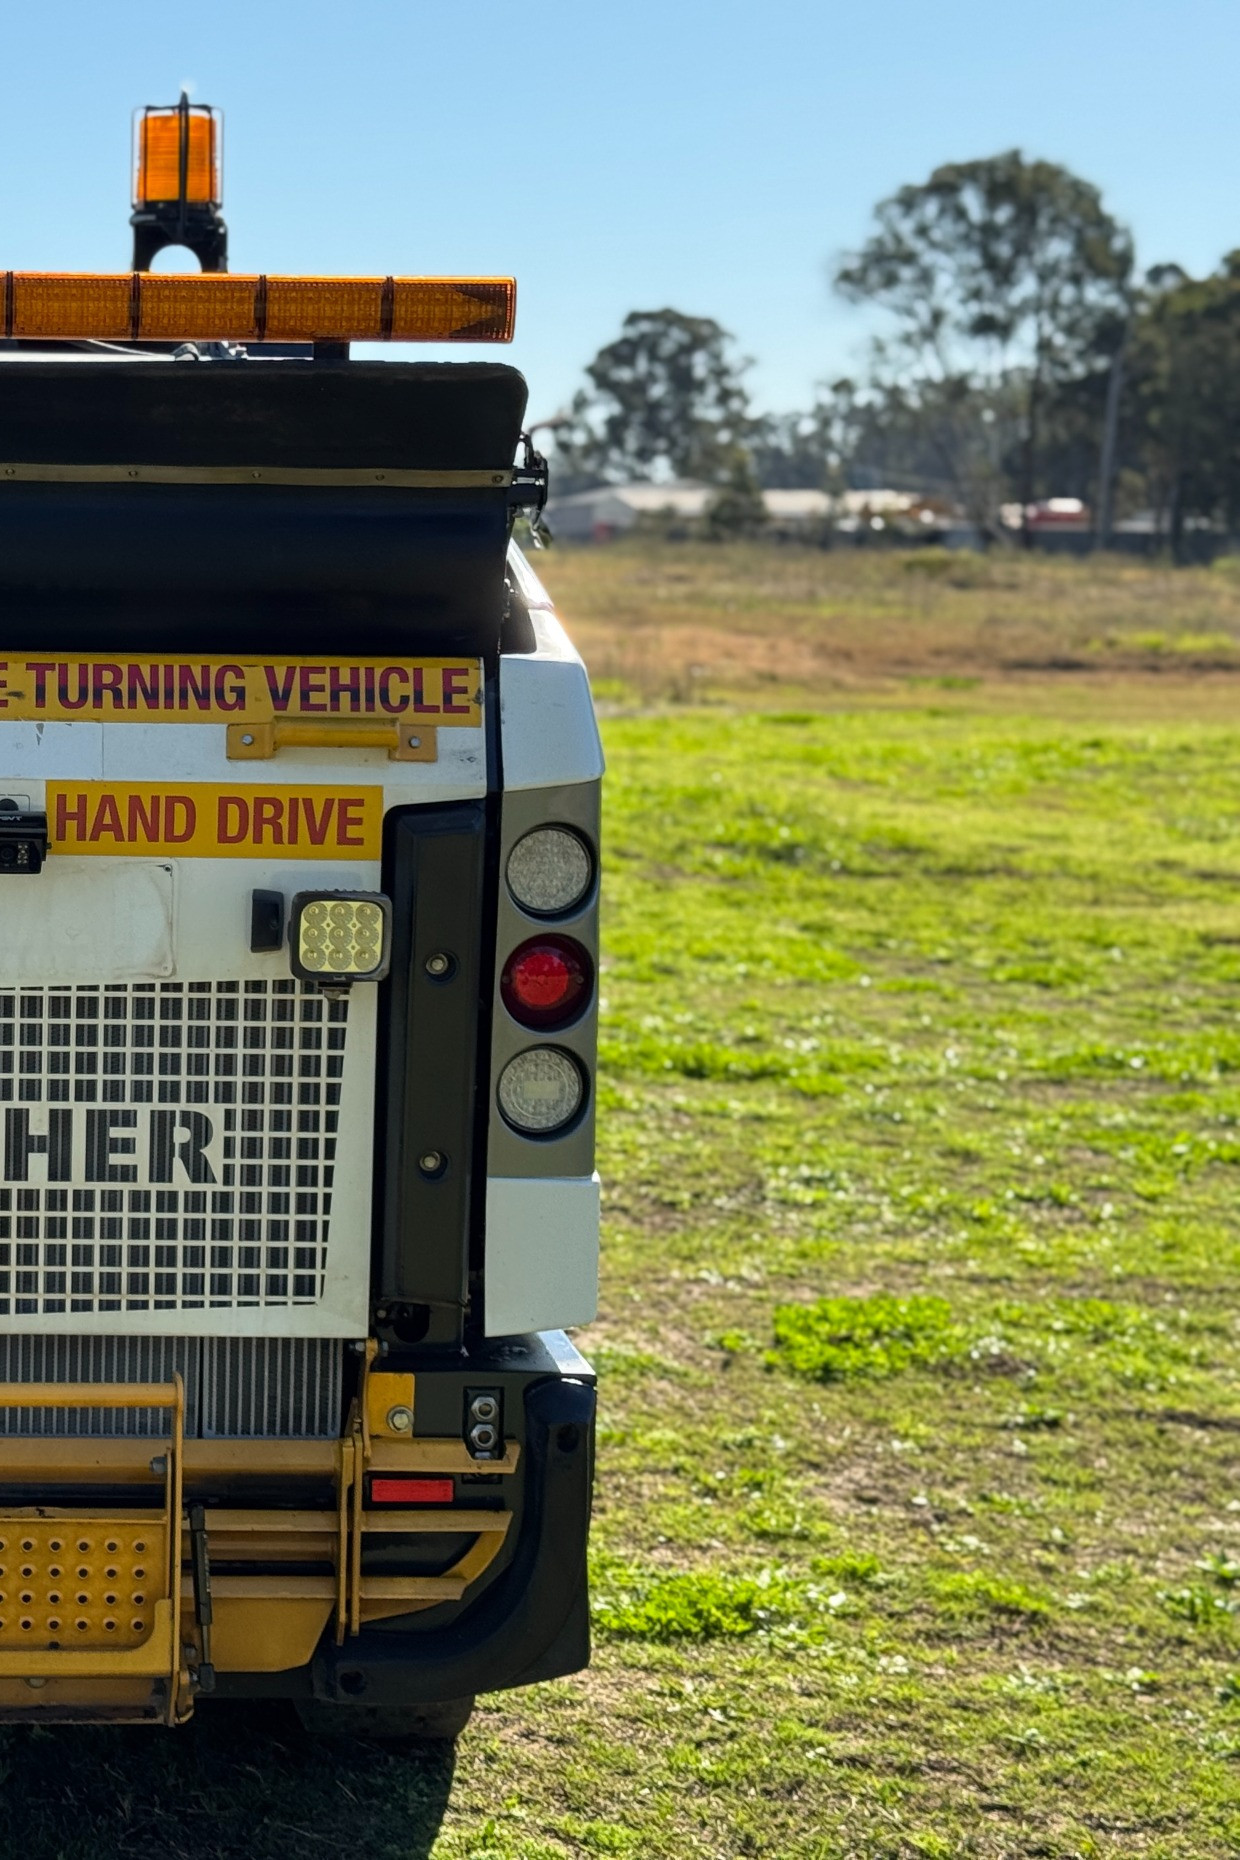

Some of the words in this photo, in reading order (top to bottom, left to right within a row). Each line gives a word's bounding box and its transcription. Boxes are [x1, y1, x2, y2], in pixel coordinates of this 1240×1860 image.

[26, 662, 247, 711] TURNING
[263, 666, 470, 714] VEHICLE
[56, 793, 196, 843] HAND
[217, 796, 365, 846] DRIVE
